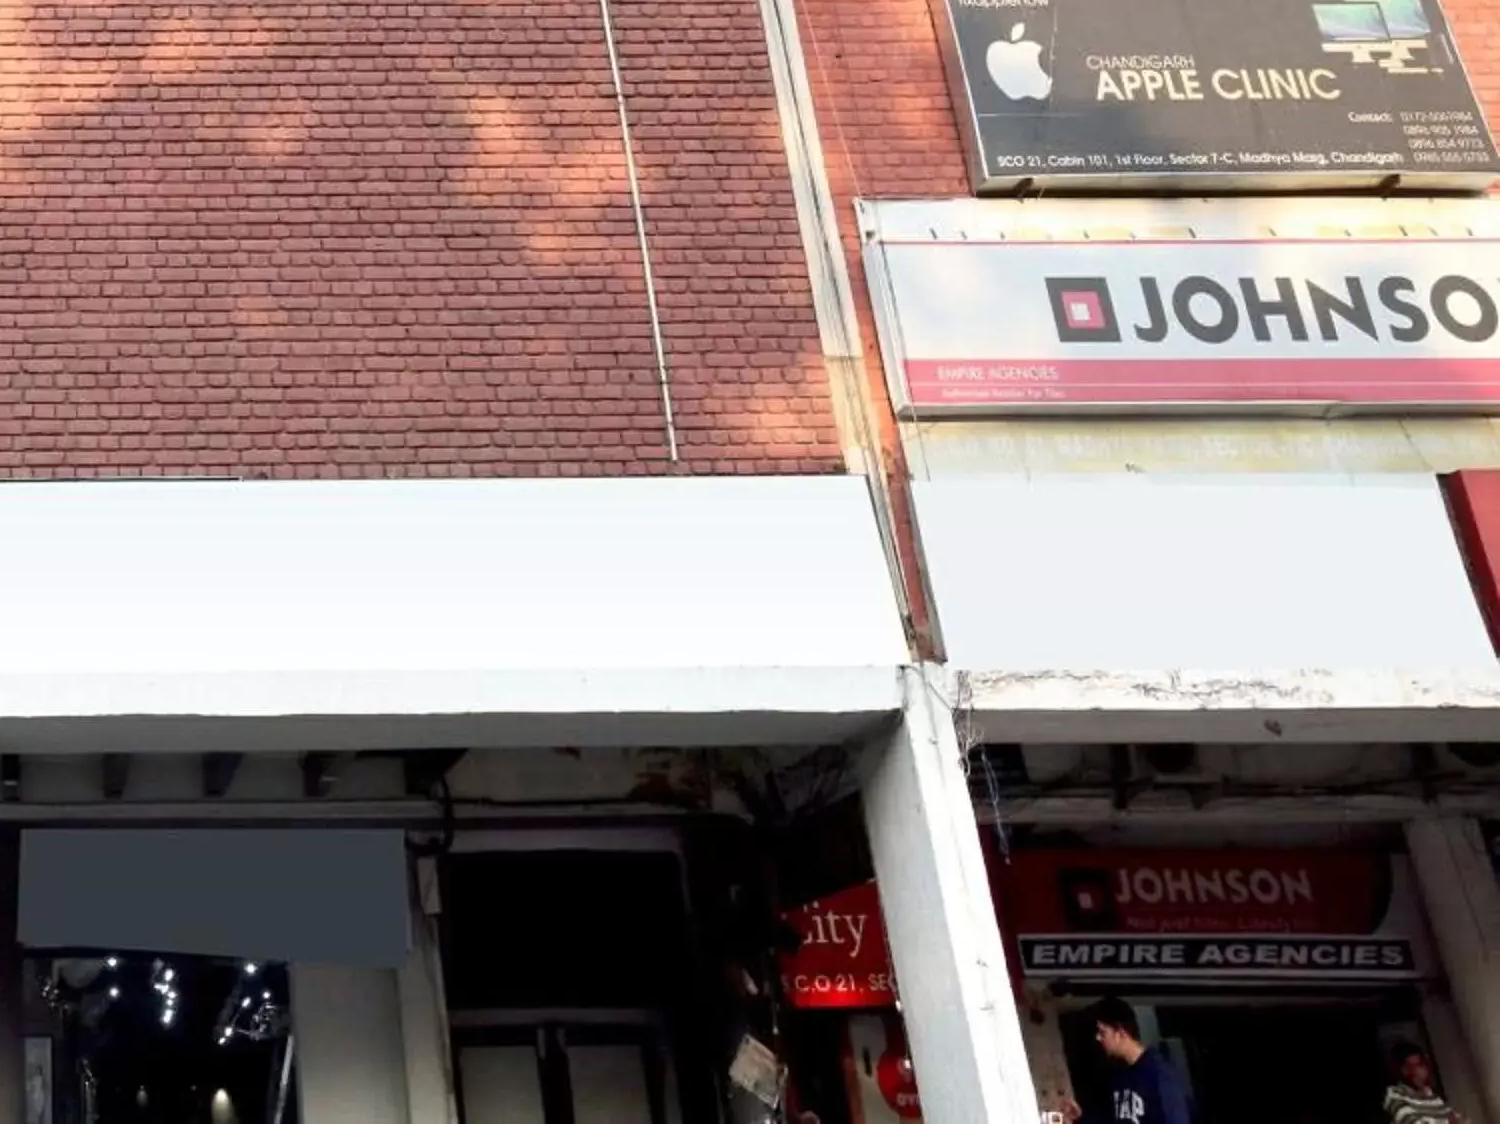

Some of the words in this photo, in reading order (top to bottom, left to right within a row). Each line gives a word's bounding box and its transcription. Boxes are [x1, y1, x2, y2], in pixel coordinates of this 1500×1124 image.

[1086, 55, 1195, 69] CHANDIGARH
[1096, 70, 1204, 102] APPLE
[1211, 70, 1342, 100] CLINIC
[998, 155, 1024, 168] SCO
[1047, 155, 1084, 167] Cabin
[1169, 153, 1208, 165] Sector
[1331, 150, 1404, 164] Chandigarh
[1134, 276, 1500, 343] JOHNSO
[988, 366, 1060, 380] AGENCIES
[1115, 868, 1313, 904] JOHNSON
[1032, 943, 1185, 966] EMPIRE
[1196, 943, 1405, 966] AGENCIES
